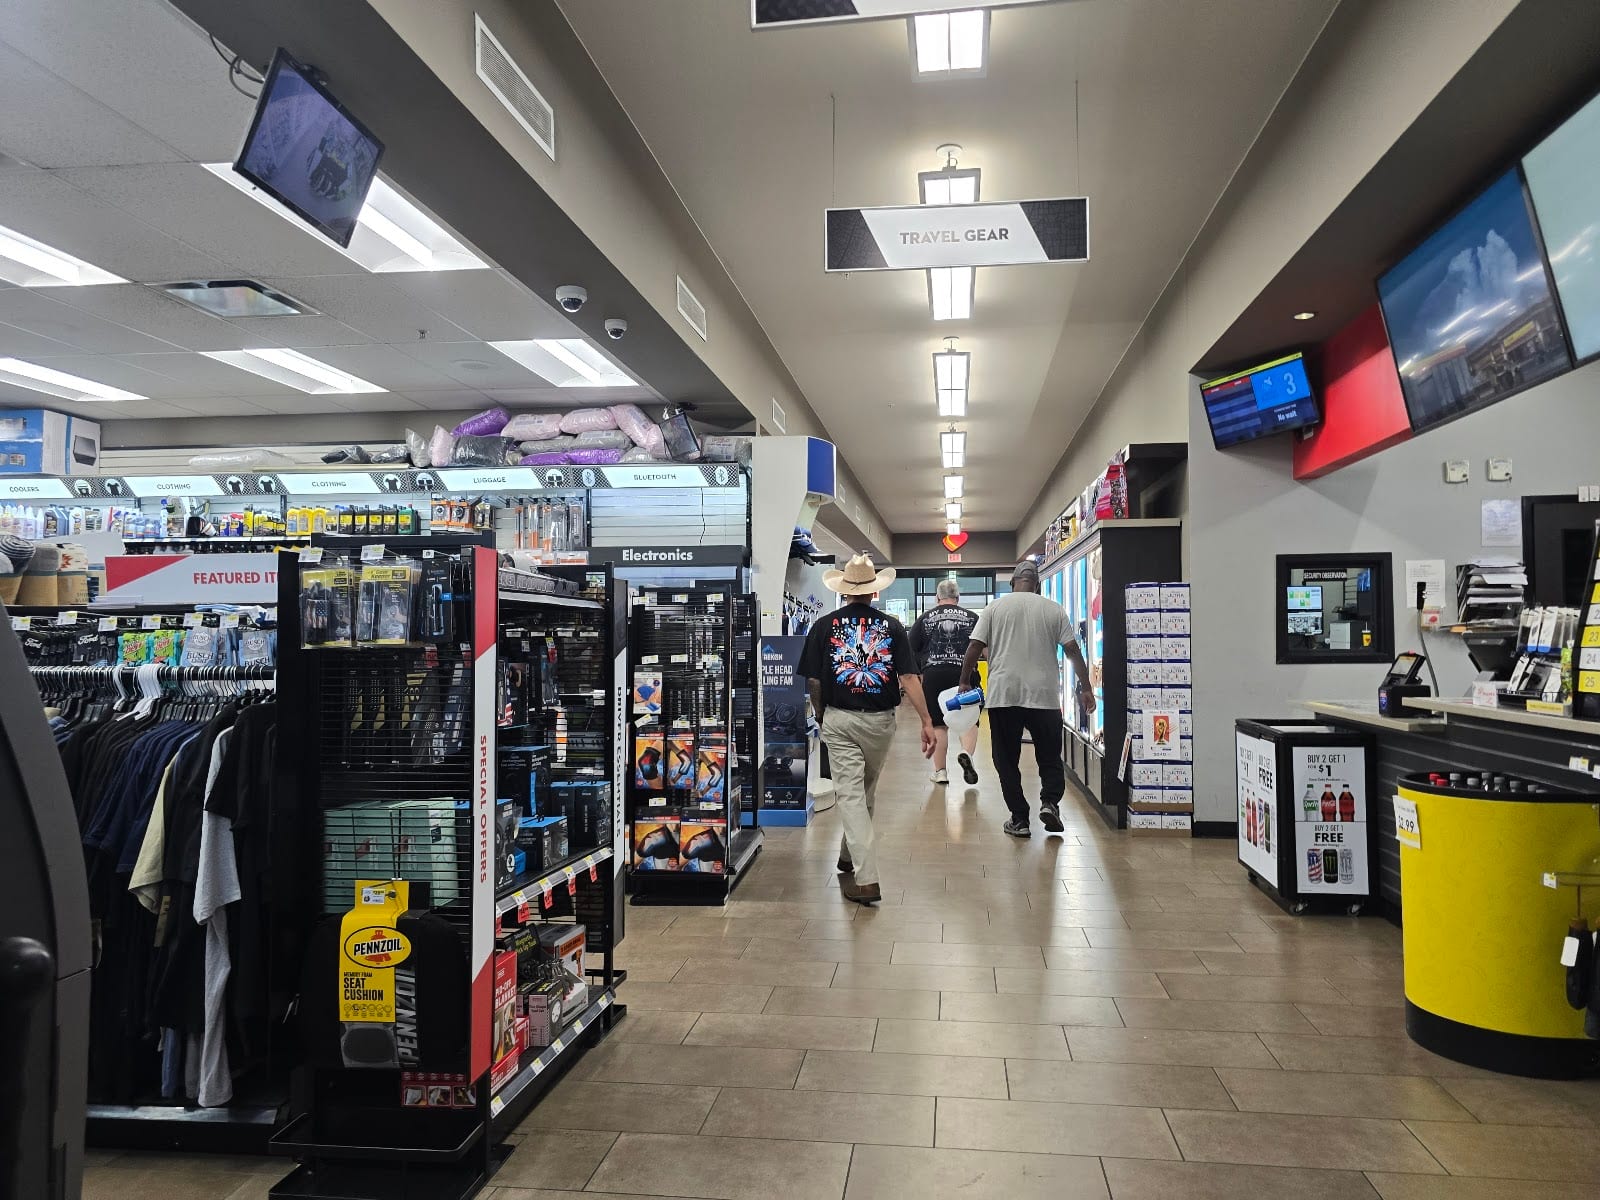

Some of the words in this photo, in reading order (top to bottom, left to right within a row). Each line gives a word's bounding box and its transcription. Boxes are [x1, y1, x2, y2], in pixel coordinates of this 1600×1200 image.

[900, 230, 960, 245] TRAVEL
[965, 228, 1009, 242] GEAR
[1283, 372, 1297, 395] 3
[473, 476, 507, 484] LUGGAGE
[622, 548, 694, 561] Electronics
[194, 572, 261, 585] FEATURED
[265, 572, 278, 584] IT
[832, 618, 888, 626] AMERICA
[78, 634, 98, 645] Ford
[1590, 632, 1598, 641] 23
[1587, 655, 1596, 664] 24
[774, 665, 793, 674] HEAD
[780, 676, 793, 686] FAN
[1585, 678, 1595, 687] 25
[1308, 754, 1320, 763] BUY
[1322, 754, 1327, 763] 2
[1328, 754, 1341, 763] GET
[1343, 754, 1346, 763] 1
[1319, 764, 1331, 776] $1
[1259, 766, 1273, 790] FREE
[1315, 833, 1344, 842] FREE
[354, 938, 402, 956] PENNZOIL
[344, 978, 366, 988] SEAT
[344, 989, 384, 1001] CUSHION
[396, 968, 418, 1060] PENNZOIL
